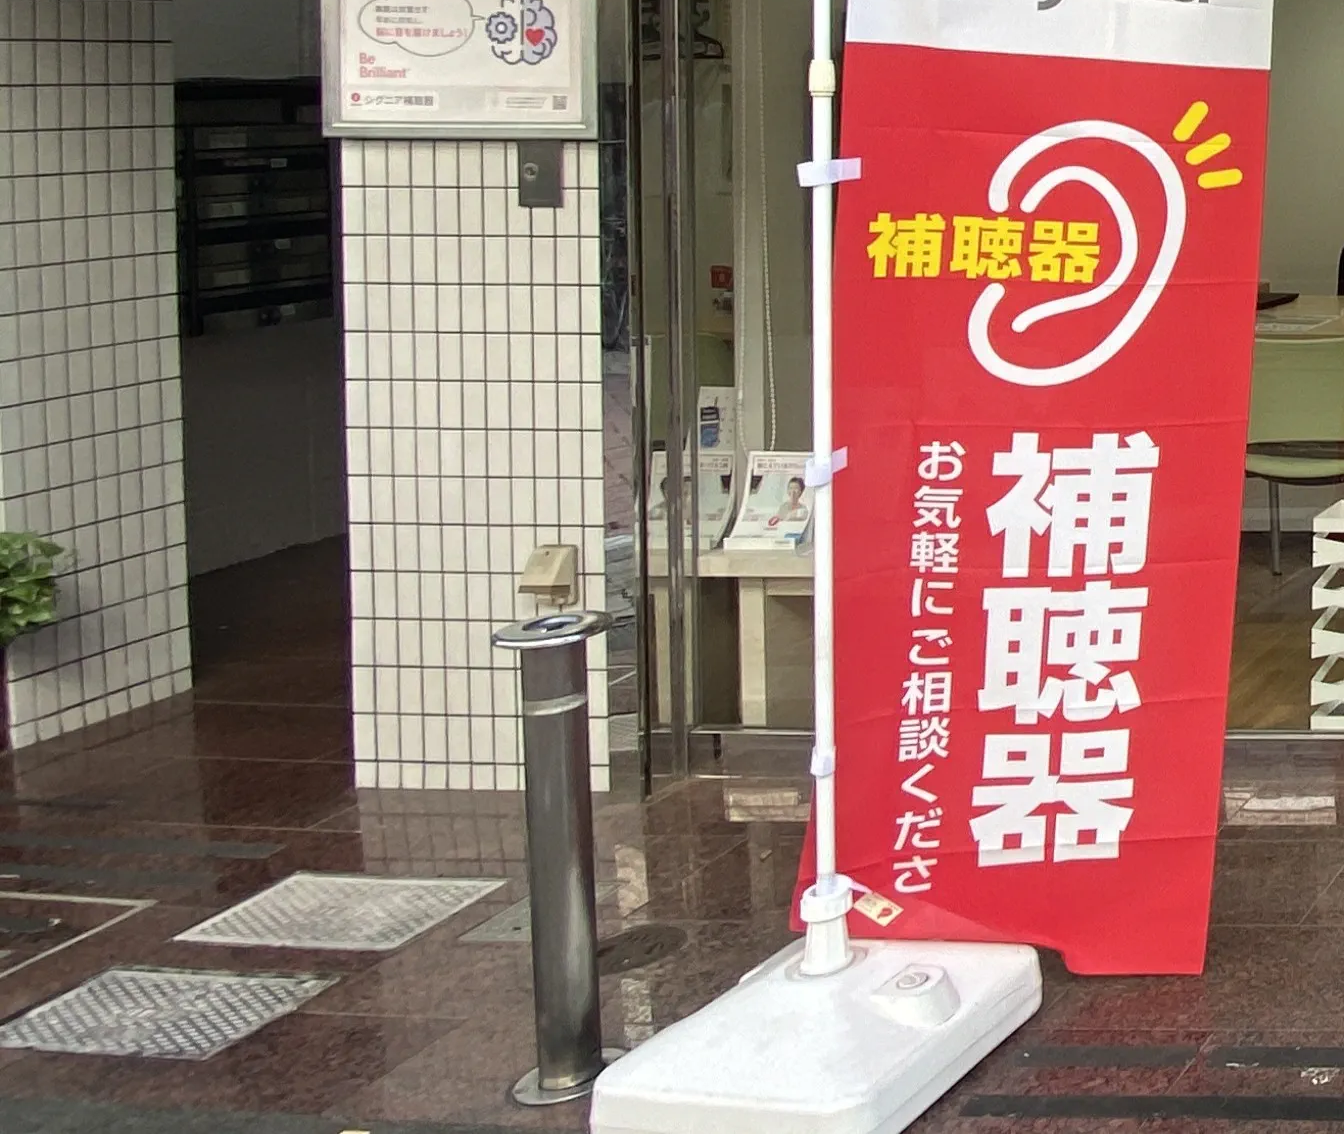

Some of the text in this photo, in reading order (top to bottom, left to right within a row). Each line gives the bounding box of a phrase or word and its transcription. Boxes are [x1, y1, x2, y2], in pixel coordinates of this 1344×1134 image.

[359, 52, 376, 64] Be
[866, 212, 1101, 285] 補聴器
[967, 430, 1161, 868] 補聴器
